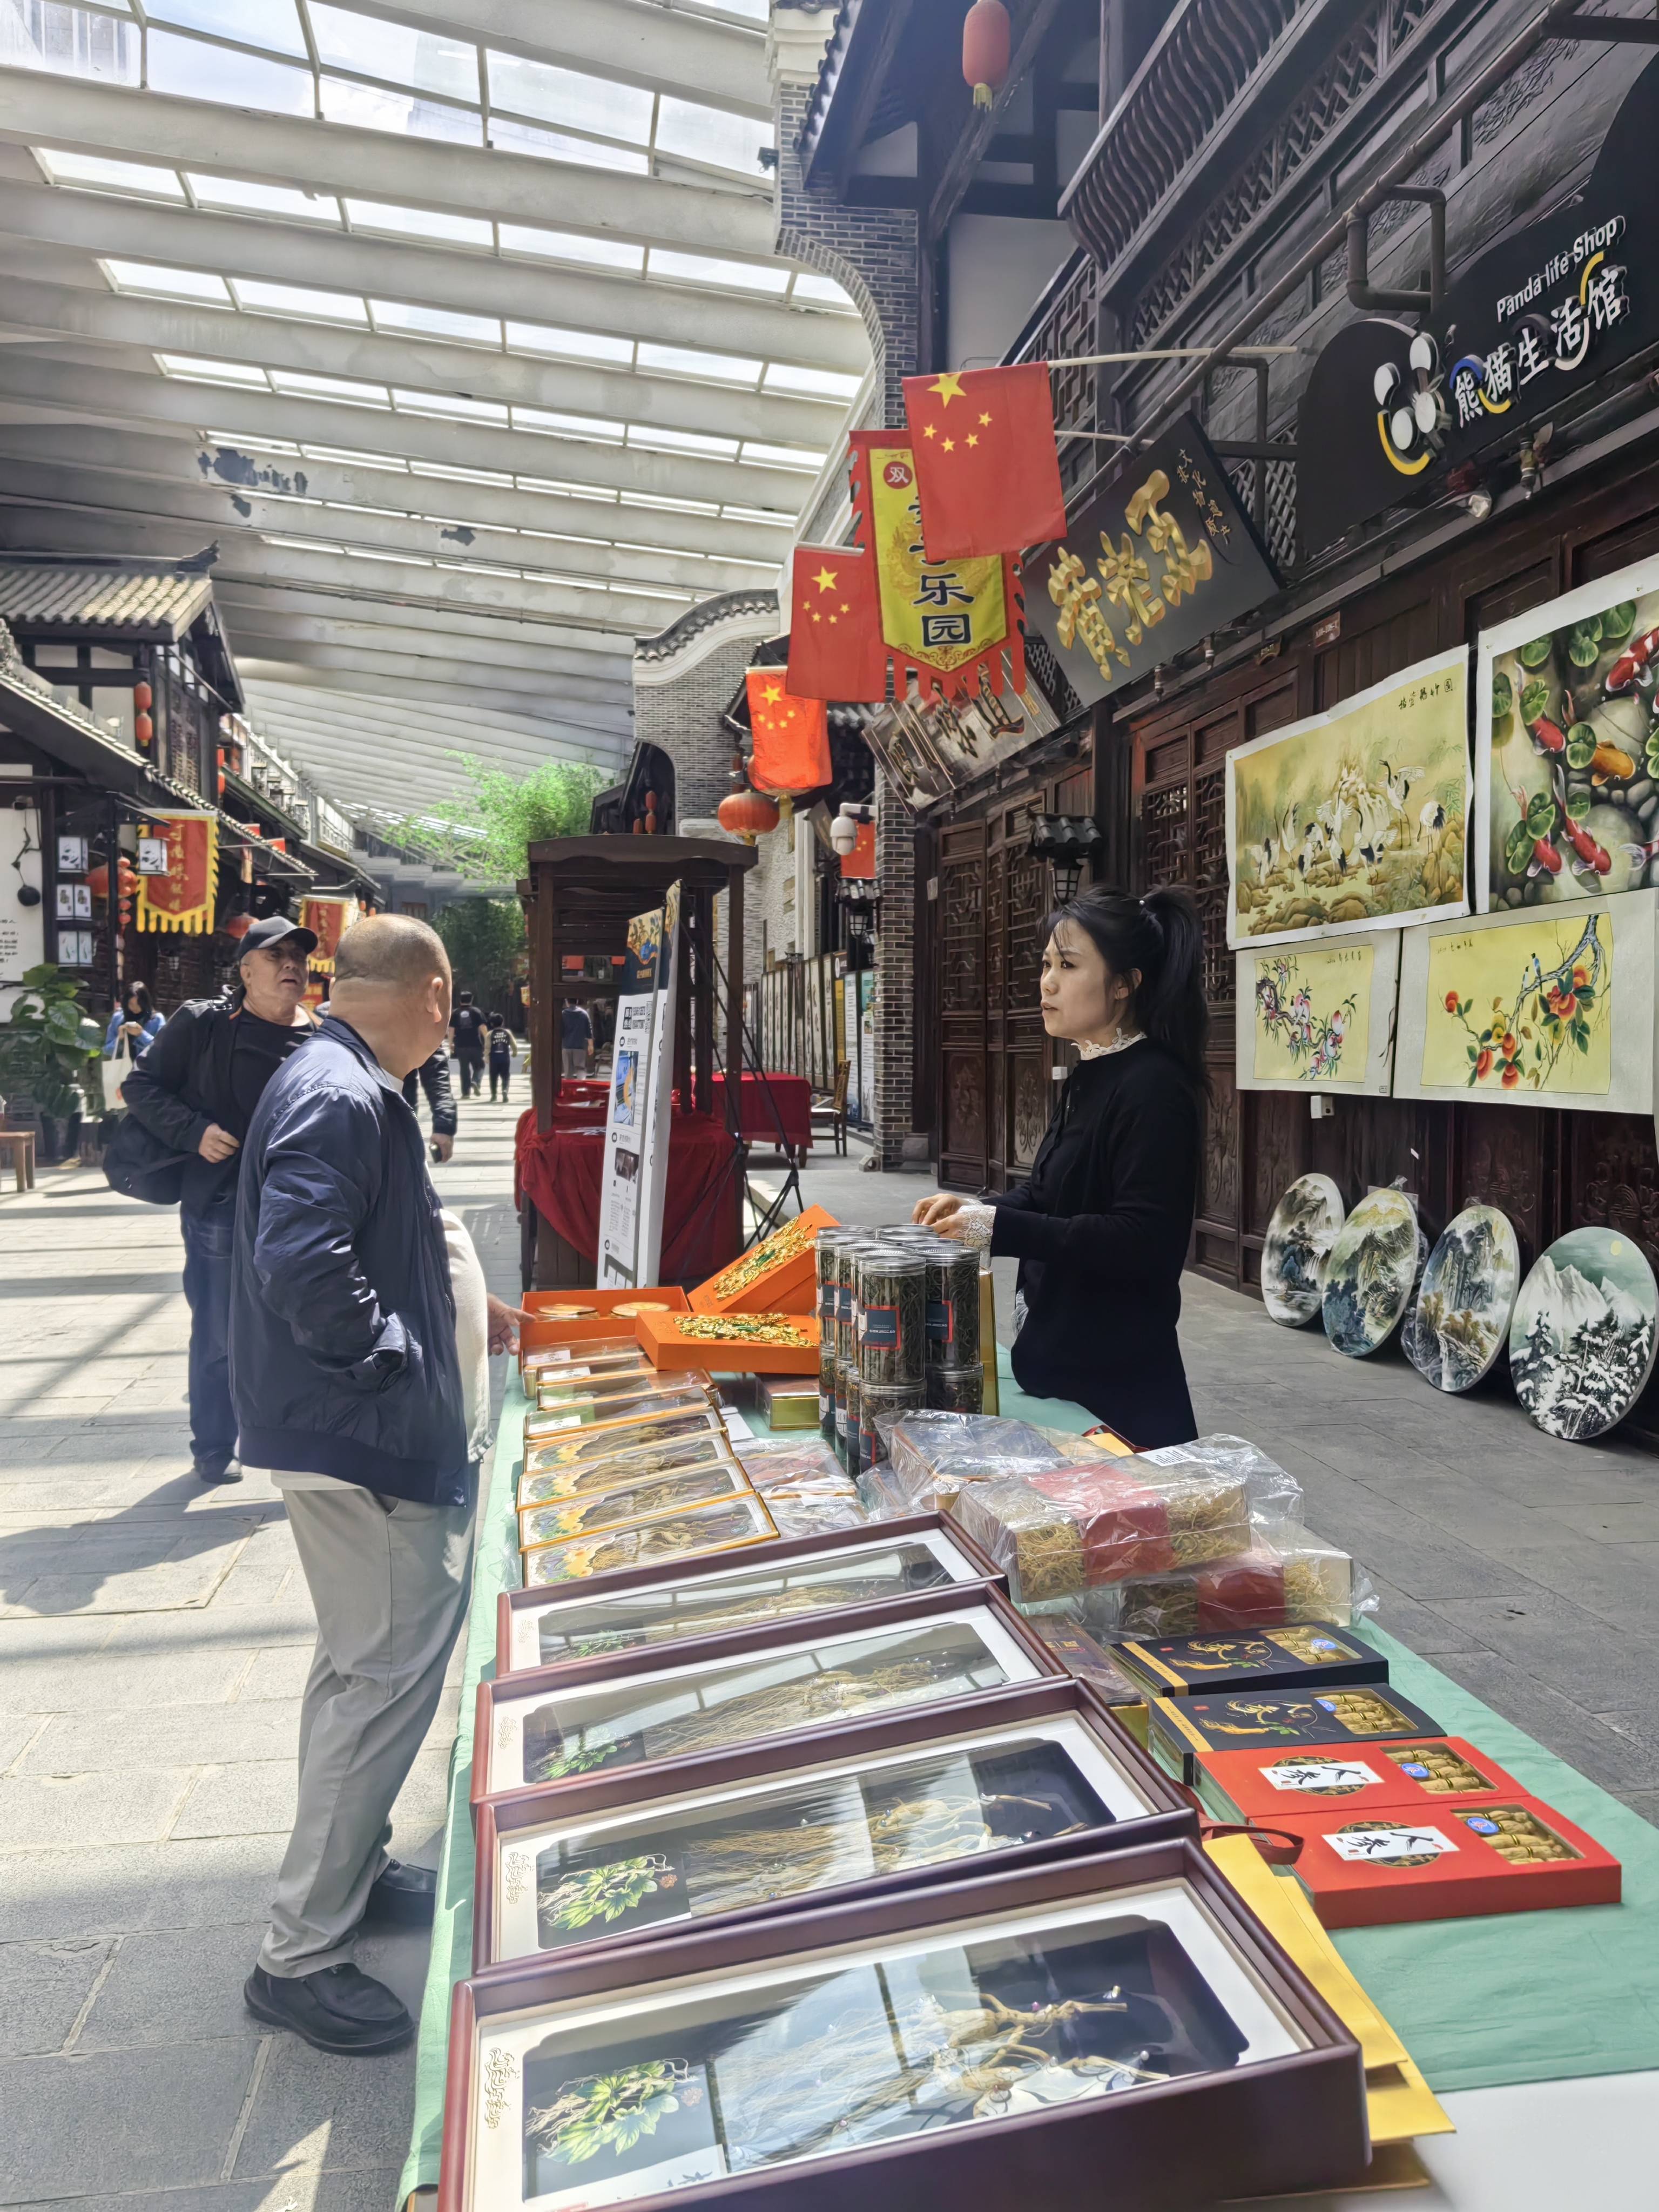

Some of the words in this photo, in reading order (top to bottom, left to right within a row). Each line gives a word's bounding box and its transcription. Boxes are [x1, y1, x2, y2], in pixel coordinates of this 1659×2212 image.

[1497, 276, 1542, 322] Panda
[1545, 254, 1569, 285] life
[1574, 220, 1617, 264] Shop
[1455, 268, 1622, 428] 熊猫生活馆
[887, 467, 909, 483] 双
